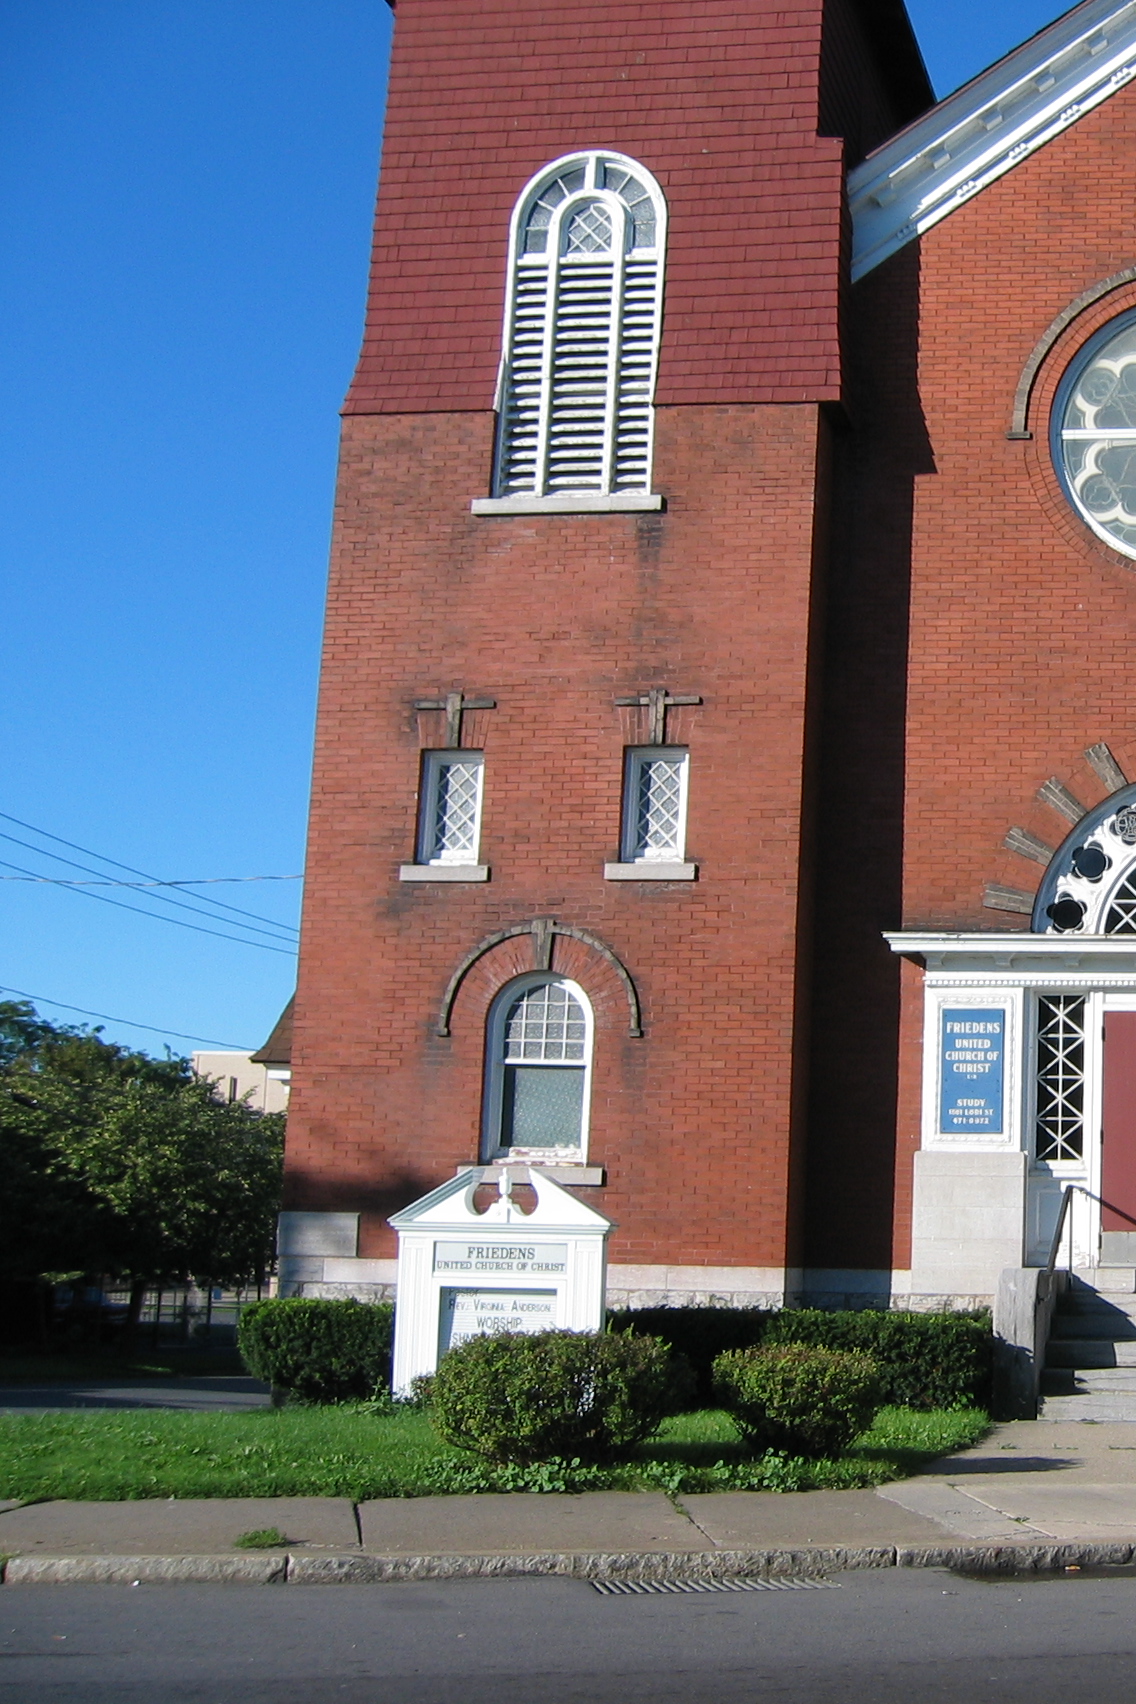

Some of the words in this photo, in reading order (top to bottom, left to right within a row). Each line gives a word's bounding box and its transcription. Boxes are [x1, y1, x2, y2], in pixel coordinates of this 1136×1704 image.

[946, 1022, 1001, 1034] FRIEDENS
[955, 1039, 991, 1049] UNITED
[945, 1051, 985, 1061] CHURCH
[986, 1051, 1000, 1061] OF
[953, 1063, 991, 1073] CHRIST
[956, 1098, 986, 1107] STUDY
[467, 1246, 536, 1260] FRIEDENS
[437, 1260, 472, 1270] UNITED
[475, 1261, 513, 1271] CHURCH
[516, 1262, 529, 1271] OF
[531, 1262, 565, 1272] CHRIST
[476, 1316, 523, 1329] WORSHIP
